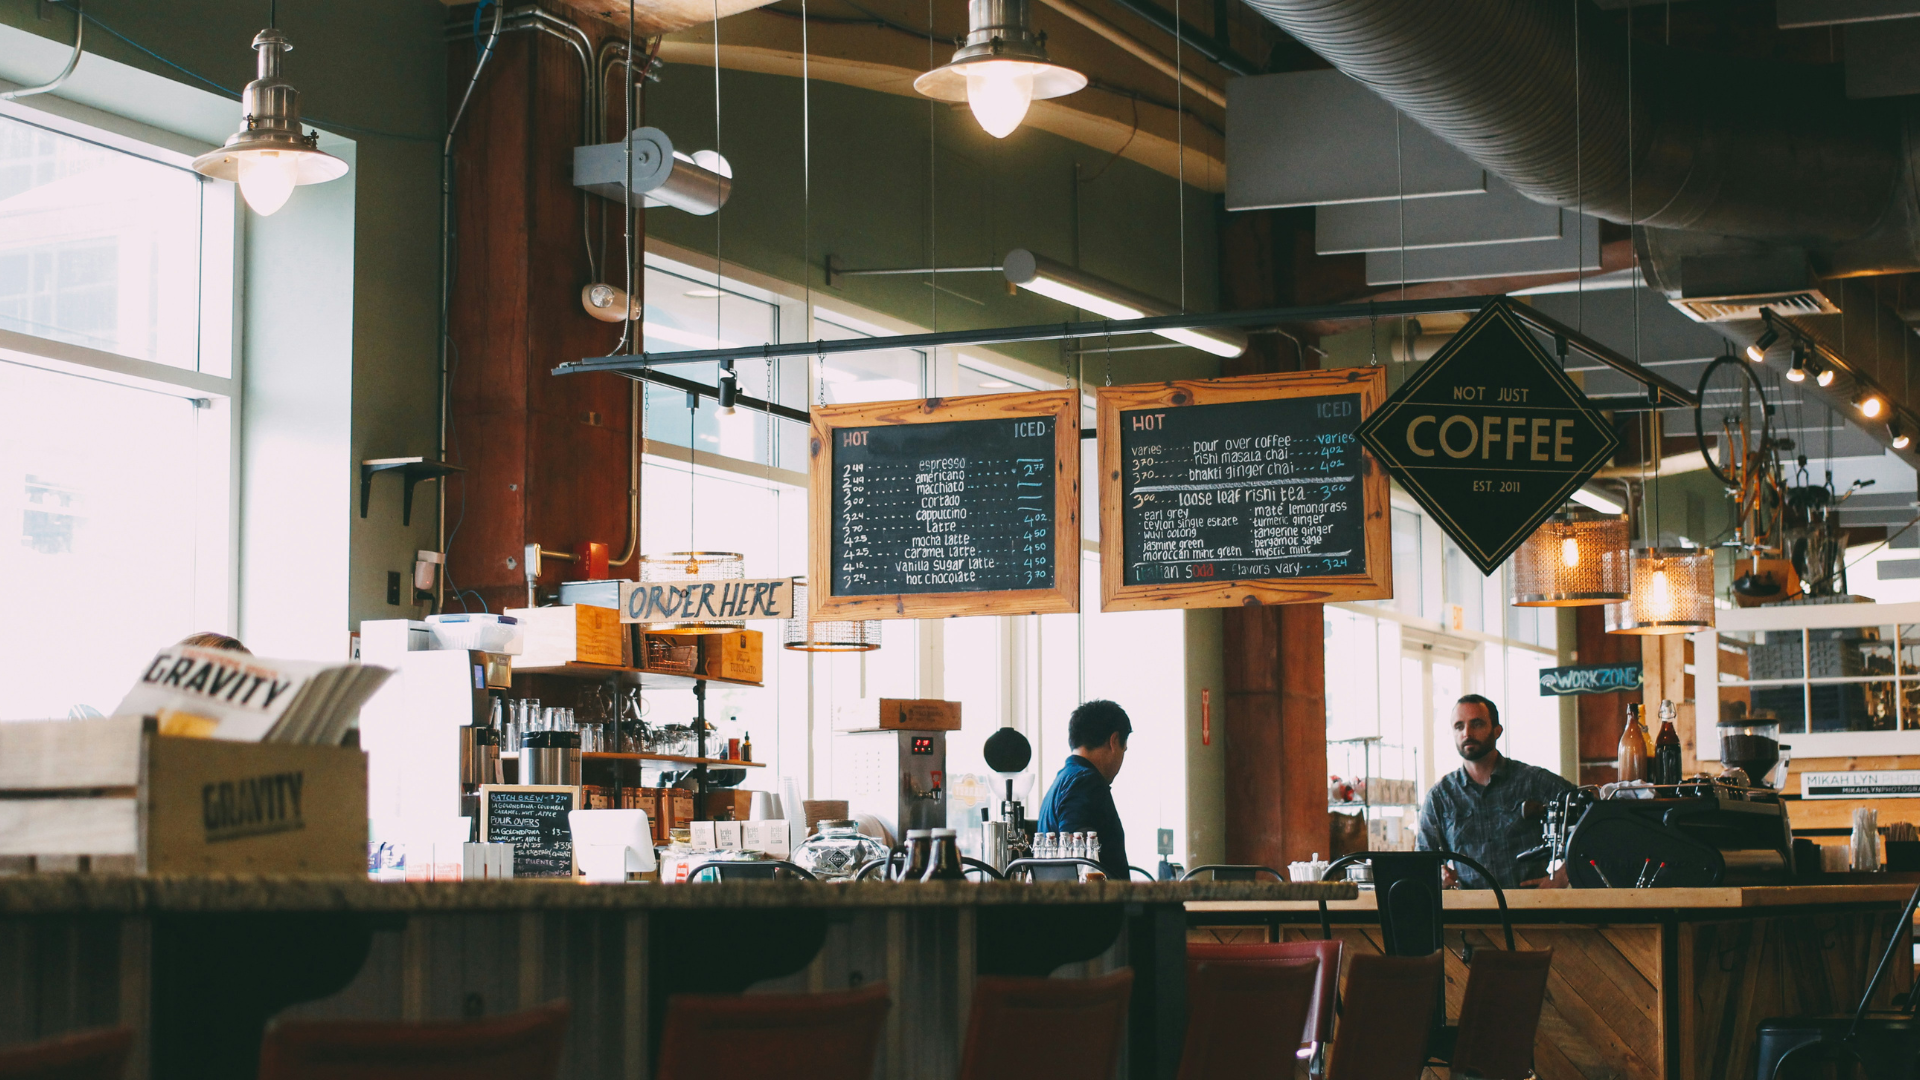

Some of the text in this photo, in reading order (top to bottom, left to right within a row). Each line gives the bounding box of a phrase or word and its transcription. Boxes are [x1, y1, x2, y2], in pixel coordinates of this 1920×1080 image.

[1453, 386, 1529, 402] NOT JUST
[1316, 401, 1352, 418] ICED
[1132, 413, 1165, 431] HOT
[843, 421, 1045, 447] HOT ICED
[1406, 414, 1575, 462] COFFEE
[1131, 433, 1355, 456] varies pour over coffee varies
[1194, 452, 1218, 465] rishi
[1221, 450, 1261, 464] masala
[1265, 447, 1288, 460] chai
[919, 458, 966, 473] espresso
[1189, 466, 1222, 481] bhakti
[1225, 462, 1265, 479] ginger
[1267, 461, 1294, 476] chai
[915, 470, 965, 483] americano
[916, 481, 964, 495] macchiato
[1473, 480, 1521, 493] EST. 2011
[921, 494, 960, 508] cortado
[1179, 492, 1213, 506] loose
[1217, 488, 1242, 504] leaf
[1245, 486, 1276, 502] rishi
[1280, 486, 1306, 501] tea
[915, 507, 967, 522] cappuccino
[1144, 508, 1189, 520] earl grey
[1288, 501, 1348, 515] lemongrass
[926, 519, 956, 533] latte
[1143, 516, 1239, 531] ceylon single estate
[1253, 513, 1325, 527] turmeric ginger
[1143, 528, 1197, 539] wuyi oolong
[1254, 523, 1334, 538] tangerine ginger
[911, 534, 941, 547] mocha
[944, 533, 970, 546] latte
[1142, 538, 1204, 552] jasmine green
[1254, 535, 1322, 548] bergamot sage
[904, 547, 945, 559] caramel
[949, 545, 976, 557] latte
[1142, 546, 1243, 561] moroccan mint green
[1255, 545, 1311, 558] mystic mint
[895, 560, 929, 572] vanilla
[933, 558, 965, 572] sugar
[968, 557, 995, 570] latte
[1231, 563, 1271, 575] flavors
[1274, 562, 1300, 576] vary
[906, 573, 923, 585] hot
[924, 570, 976, 585] chocolate
[629, 581, 784, 619] ORDER HERE
[142, 655, 291, 708] GRAVITY
[1807, 775, 1849, 785] MIKAH
[1853, 774, 1878, 784] LYN
[202, 770, 304, 830] GRAVITY
[490, 793, 516, 802] BATCH
[518, 794, 544, 803] BREW
[490, 815, 540, 828] POUR OVERS
